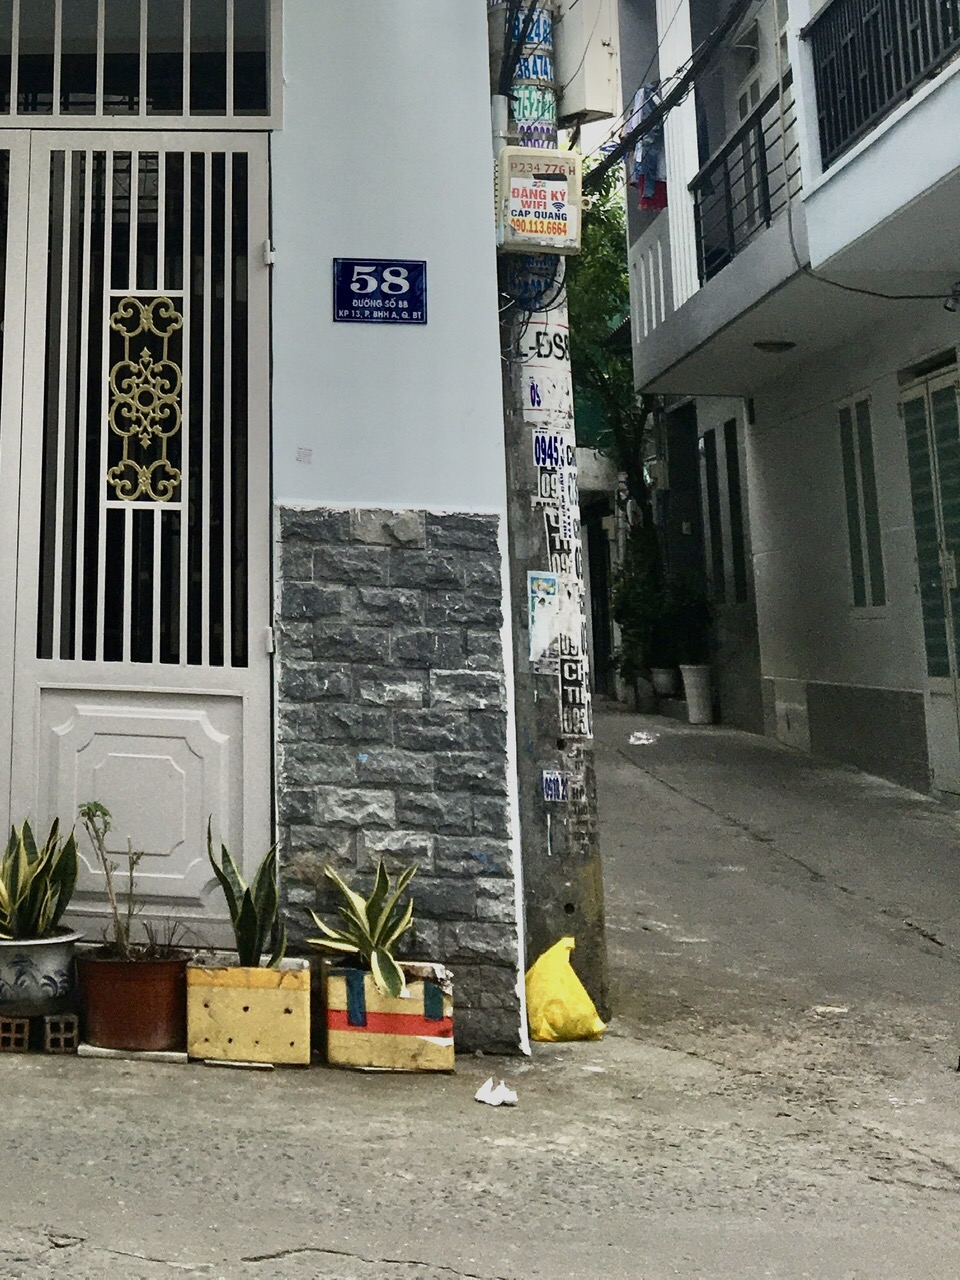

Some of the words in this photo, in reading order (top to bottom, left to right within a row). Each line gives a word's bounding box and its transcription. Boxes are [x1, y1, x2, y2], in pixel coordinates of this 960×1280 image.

[511, 186, 547, 201] ĐĂNG
[550, 188, 566, 202] KÝ
[520, 199, 547, 210] WIFI
[534, 210, 568, 221] QUANG
[350, 266, 410, 294] 58
[352, 298, 383, 308] ĐƯỜNG
[384, 297, 396, 308] SỐ
